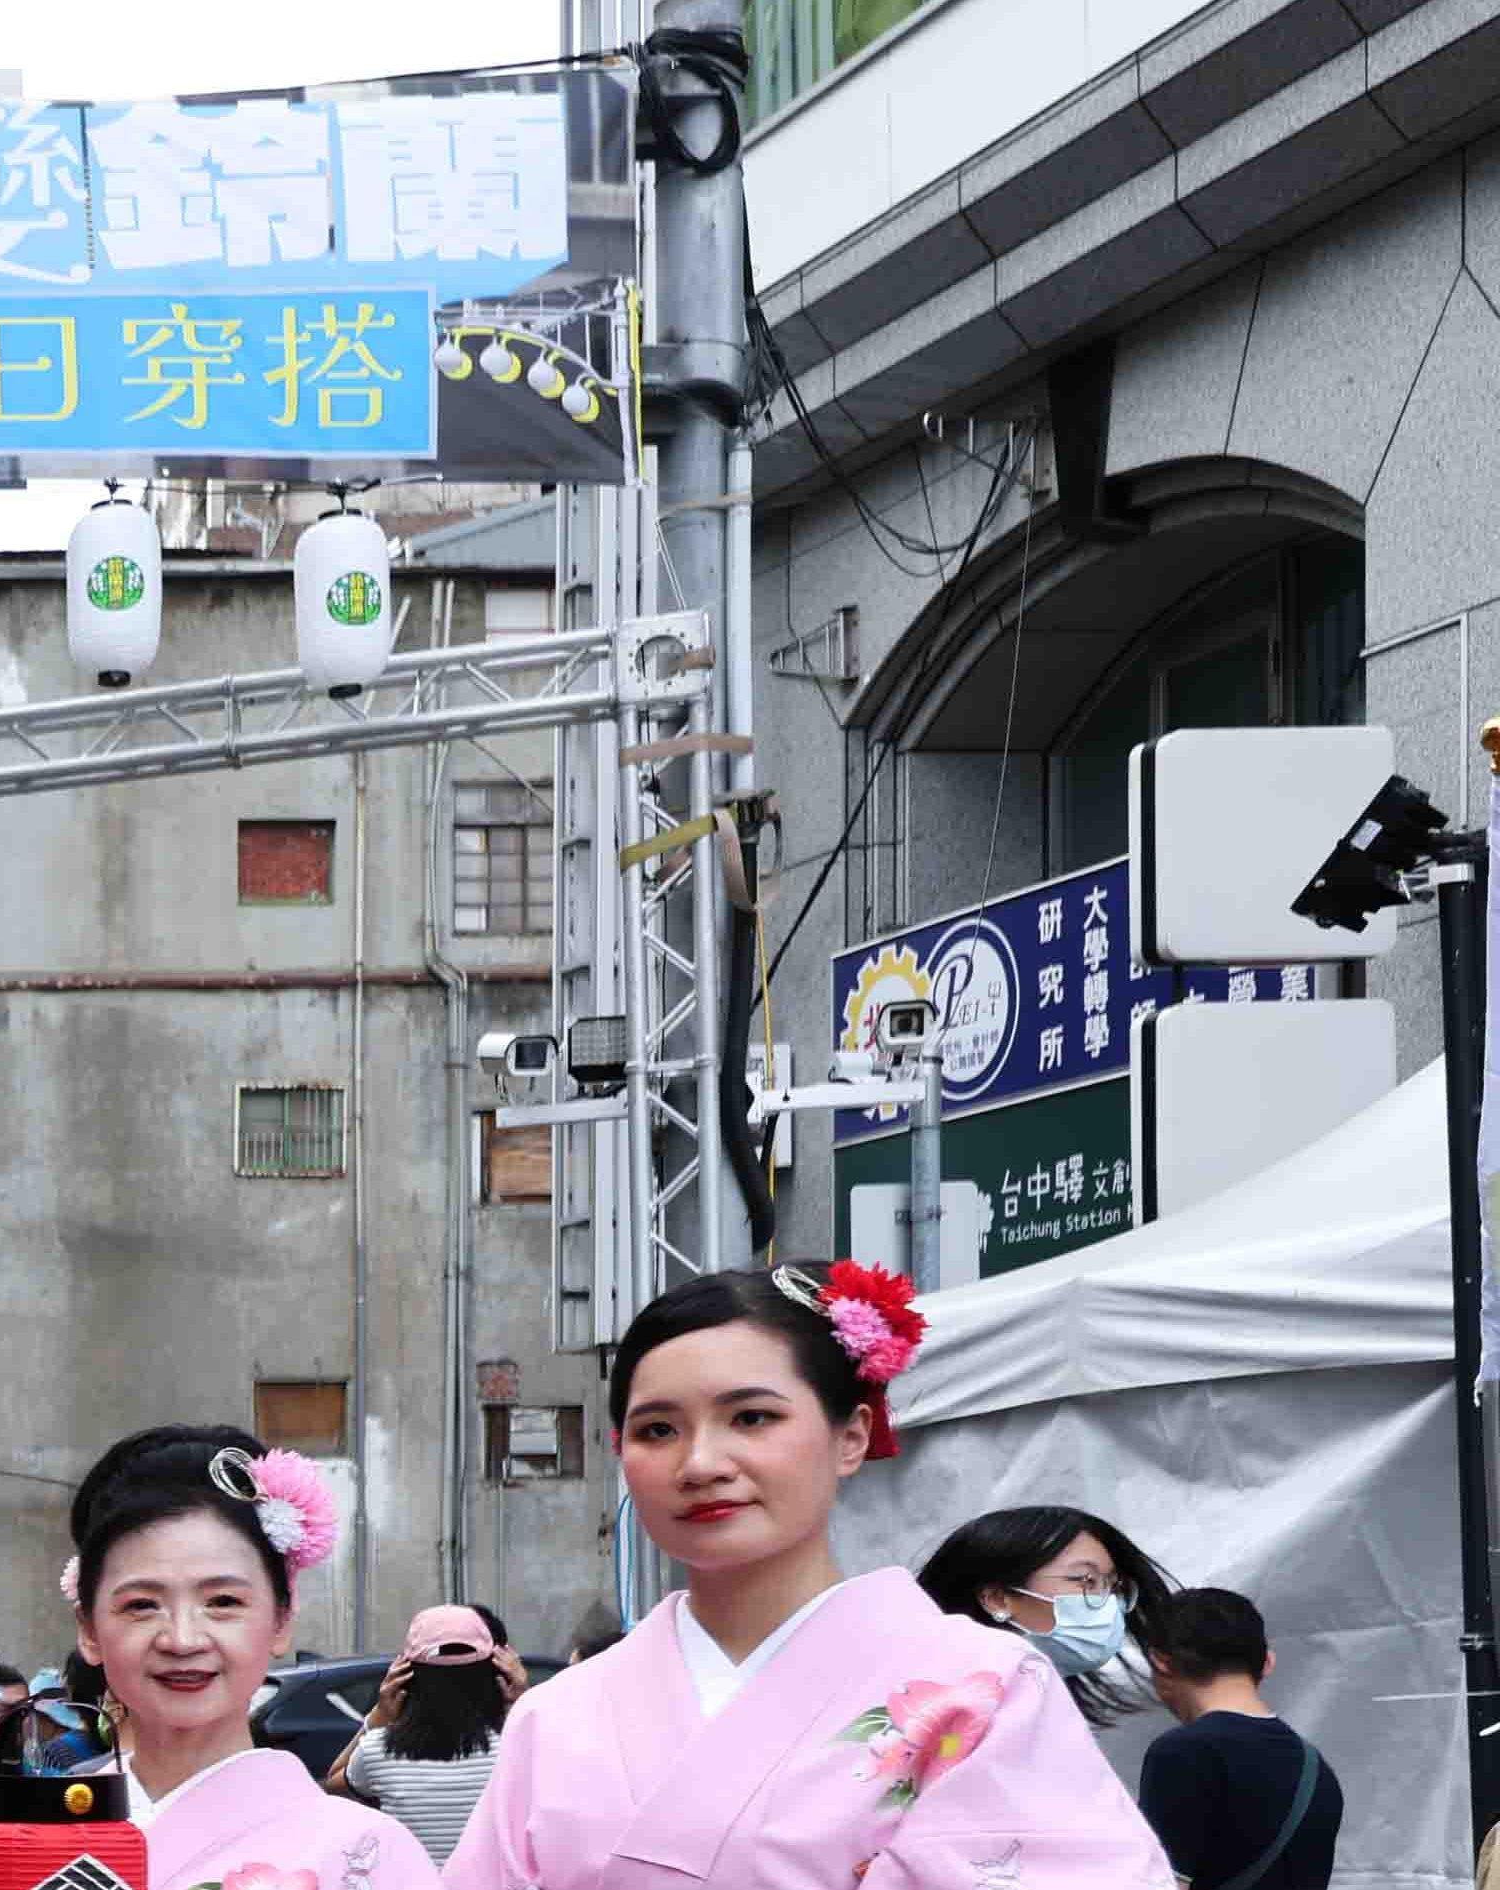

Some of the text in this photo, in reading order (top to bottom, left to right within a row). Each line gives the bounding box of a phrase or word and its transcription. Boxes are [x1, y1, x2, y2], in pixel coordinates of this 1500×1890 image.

[1038, 898, 1064, 1072] 研究所
[1083, 885, 1110, 1058] 大學轉學
[1001, 1152, 1085, 1219] 台中驛
[1001, 1218, 1060, 1246] Taichung
[1065, 1207, 1121, 1232] Station
